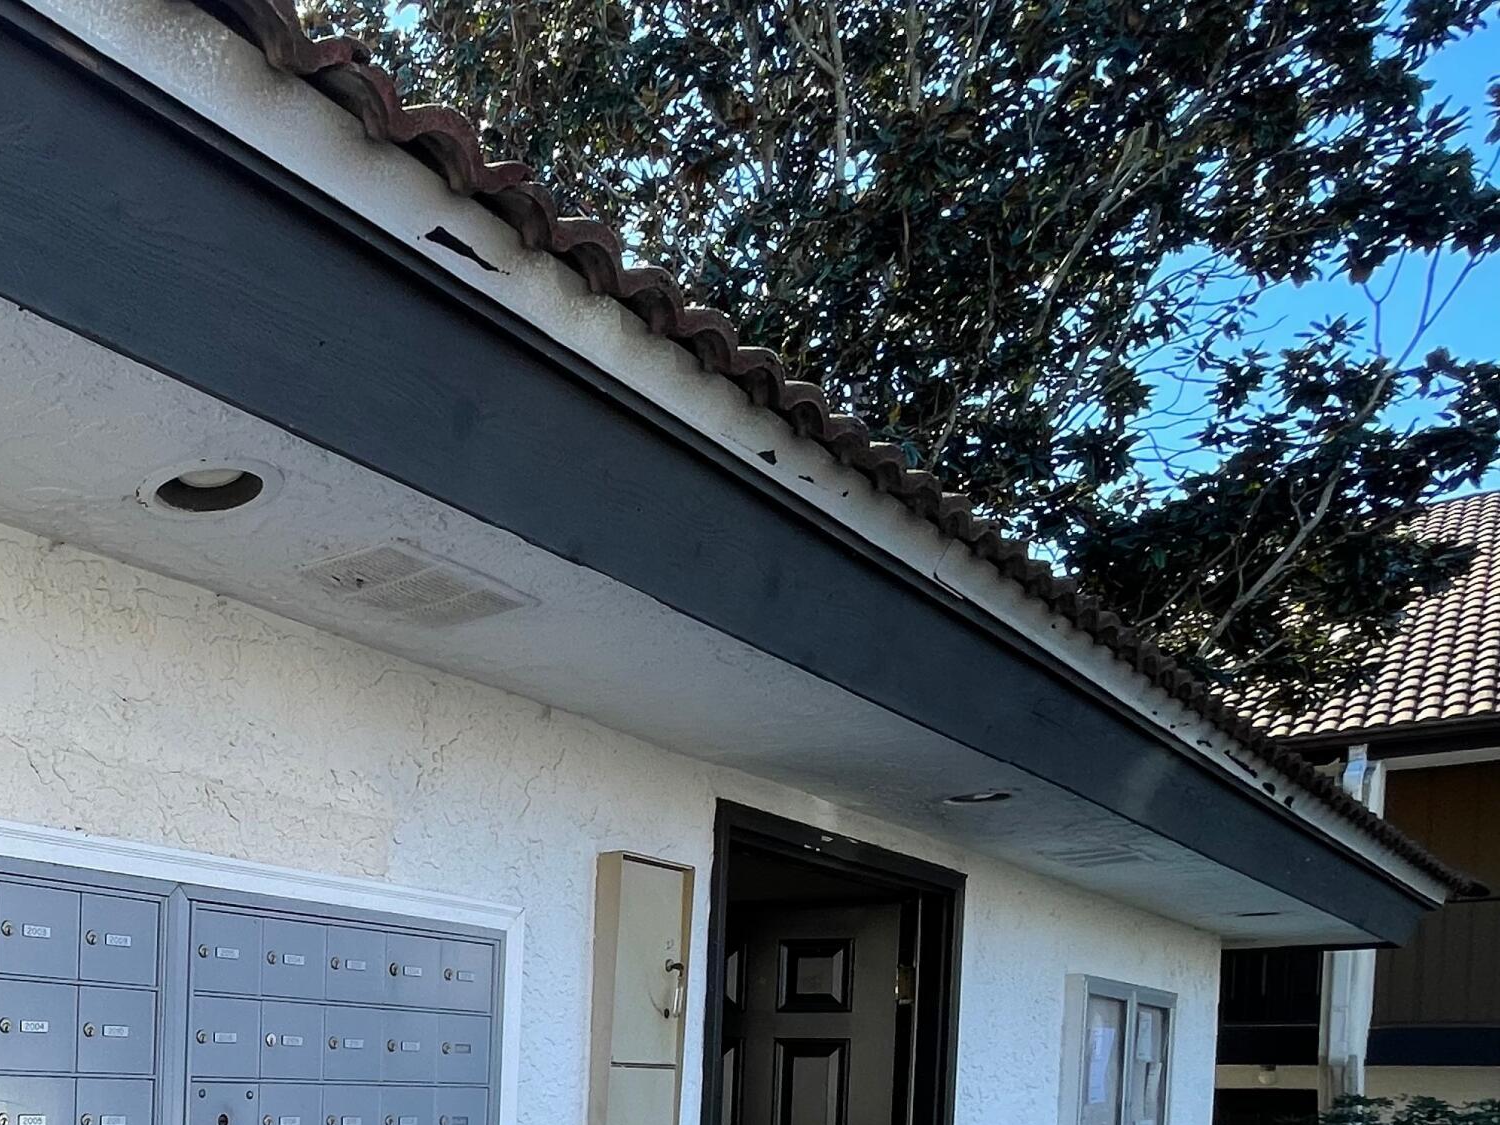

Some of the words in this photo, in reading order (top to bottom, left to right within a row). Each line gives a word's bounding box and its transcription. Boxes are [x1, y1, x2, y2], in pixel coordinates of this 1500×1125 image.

[26, 927, 47, 937] 2003
[24, 1022, 45, 1030] 2004
[23, 1116, 43, 1125] 2005
